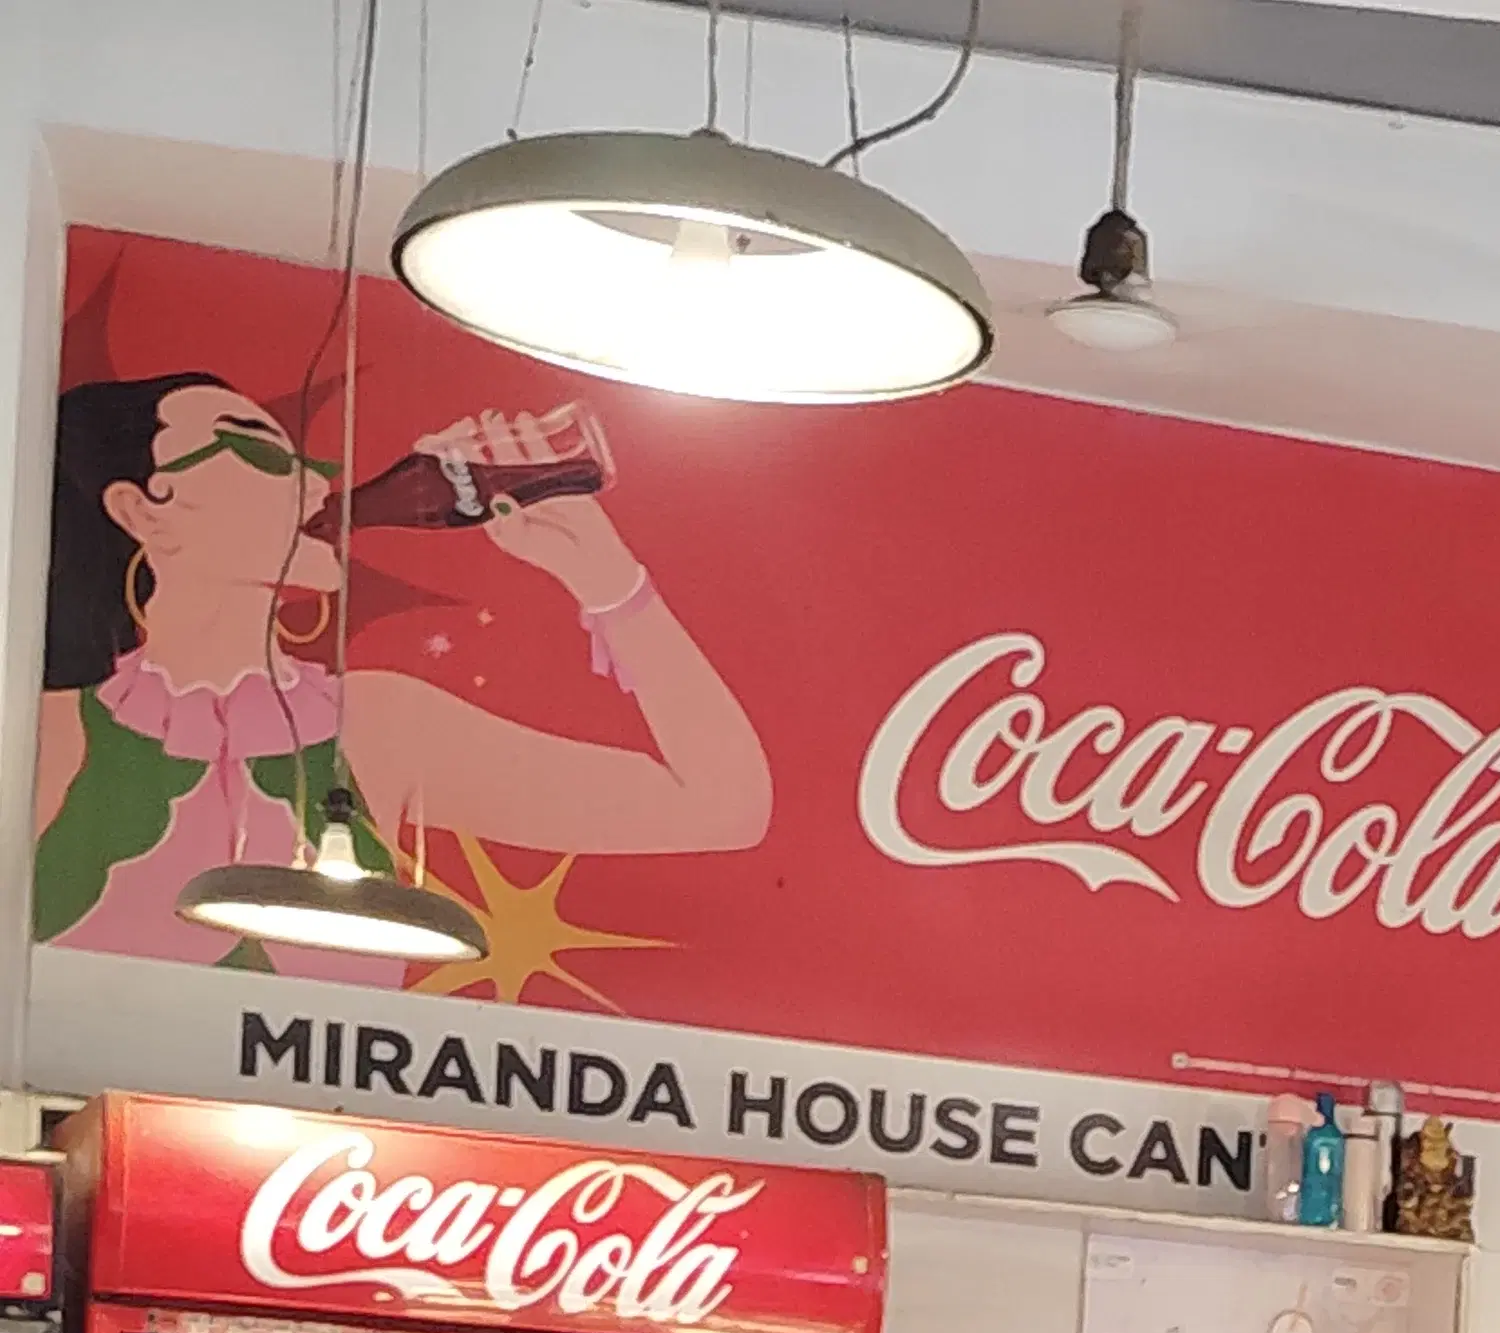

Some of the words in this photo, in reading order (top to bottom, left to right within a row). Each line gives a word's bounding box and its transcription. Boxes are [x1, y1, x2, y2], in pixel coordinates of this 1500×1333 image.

[239, 1011, 696, 1130] MIRANDA
[726, 1069, 1040, 1168] HOUSE
[240, 1131, 765, 1322] Coca-Cola
